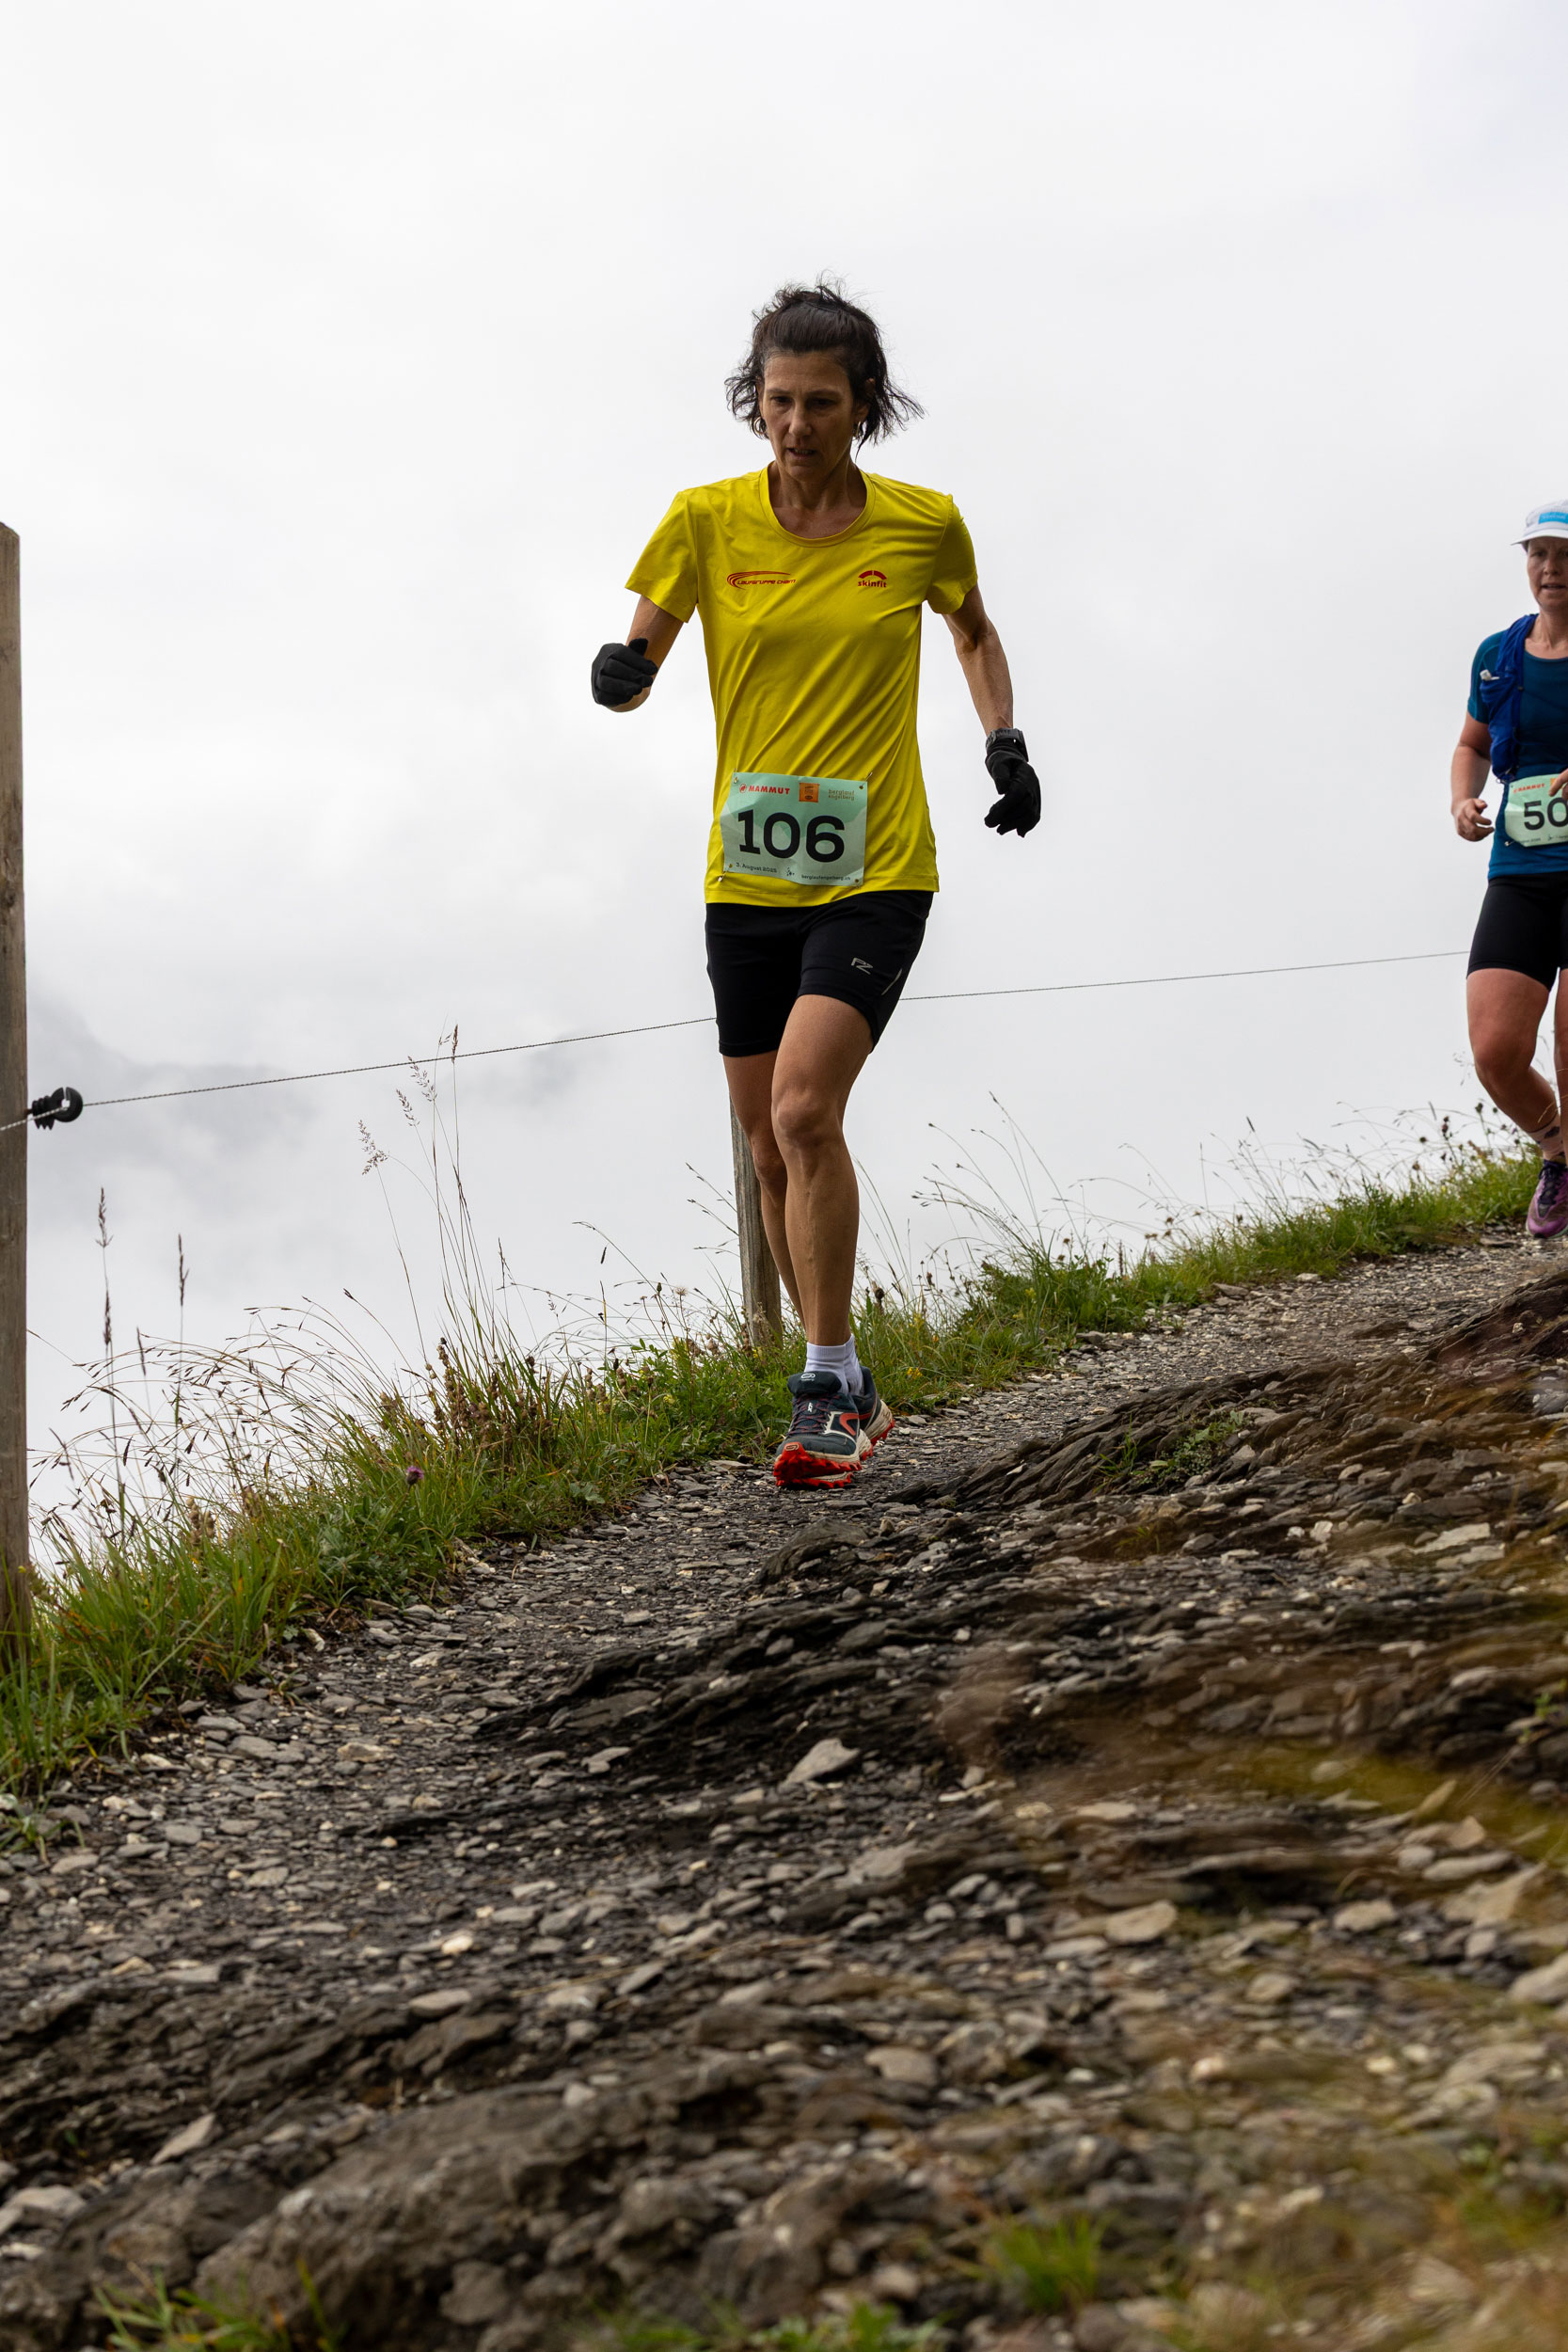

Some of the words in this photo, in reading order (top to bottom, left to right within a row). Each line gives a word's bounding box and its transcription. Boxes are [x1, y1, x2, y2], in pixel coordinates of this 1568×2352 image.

[858, 580, 887, 588] skinfit
[748, 785, 790, 795] MAMMUT
[1524, 797, 1568, 831] 50
[737, 809, 845, 863] 106
[742, 863, 762, 871] August
